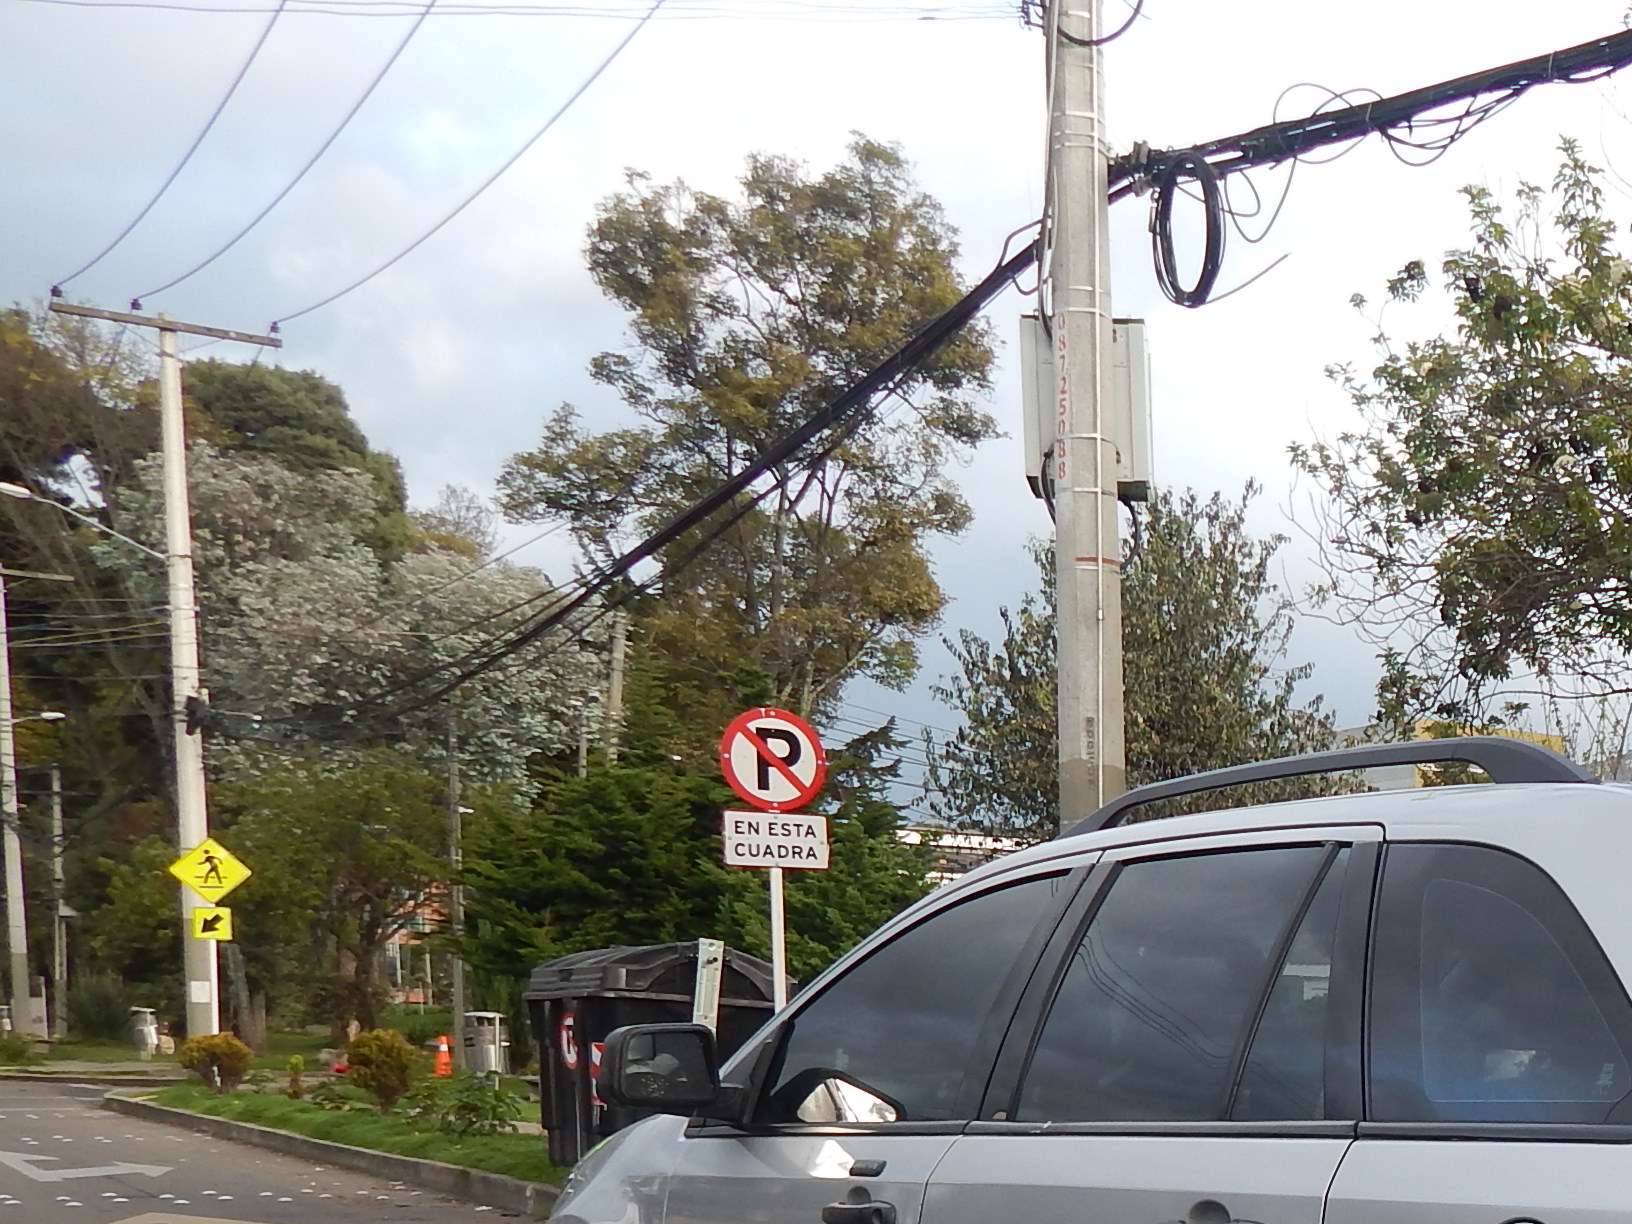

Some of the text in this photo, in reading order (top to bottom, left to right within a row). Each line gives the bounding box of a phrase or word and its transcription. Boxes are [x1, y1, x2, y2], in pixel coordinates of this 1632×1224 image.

[755, 726, 802, 791] P
[734, 820, 817, 838] EN ESTA
[734, 843, 818, 860] CUADRA
